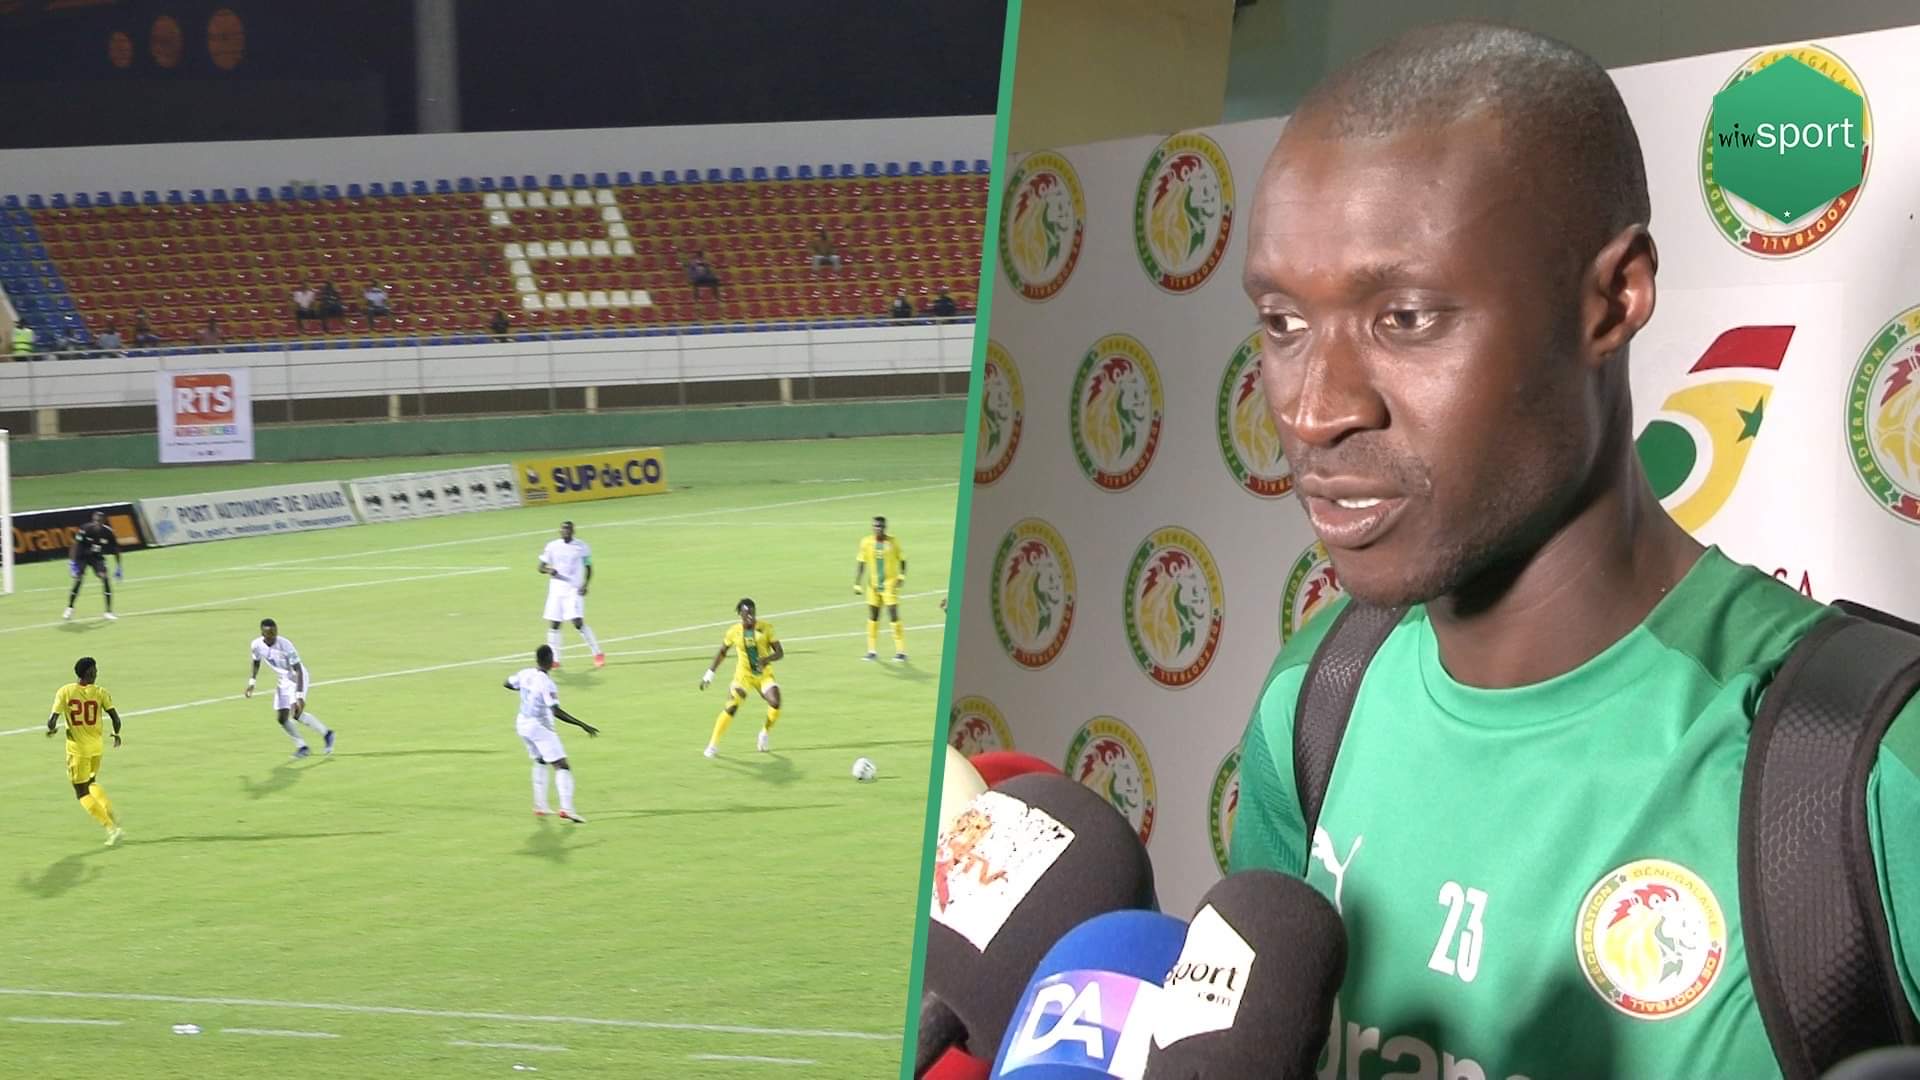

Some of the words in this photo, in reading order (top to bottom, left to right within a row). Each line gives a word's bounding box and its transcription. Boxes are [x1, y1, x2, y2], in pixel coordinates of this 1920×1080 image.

[175, 384, 233, 415] RTS
[552, 464, 597, 493] SUP
[601, 464, 625, 488] de
[626, 458, 661, 486] CO
[176, 503, 213, 524] PORT
[67, 698, 98, 726] 20
[1426, 881, 1489, 983] 23
